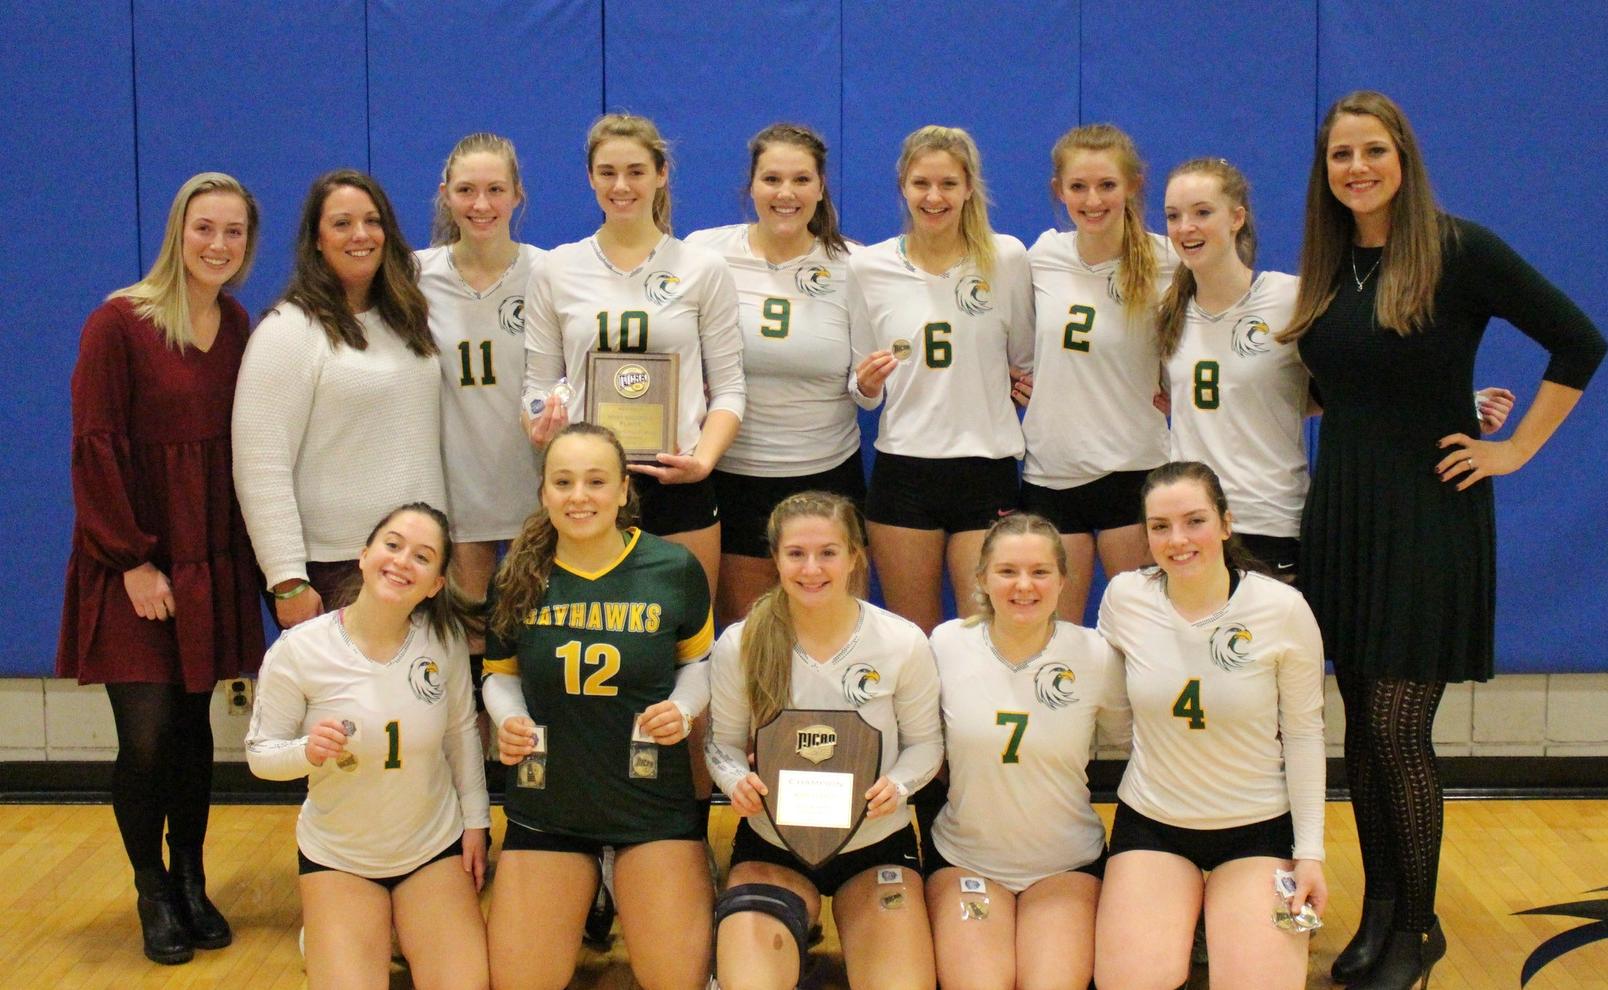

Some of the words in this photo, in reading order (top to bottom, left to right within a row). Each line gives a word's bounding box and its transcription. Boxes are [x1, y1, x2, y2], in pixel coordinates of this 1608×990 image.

[596, 310, 649, 353] 10
[760, 297, 791, 339] 9
[1063, 304, 1096, 353] 2
[457, 339, 496, 387] 11
[923, 321, 953, 369] 6
[1193, 359, 1220, 410] 8
[555, 640, 621, 697] 12
[1171, 678, 1206, 730] 4
[384, 720, 402, 770] 1
[995, 711, 1029, 764] 7
